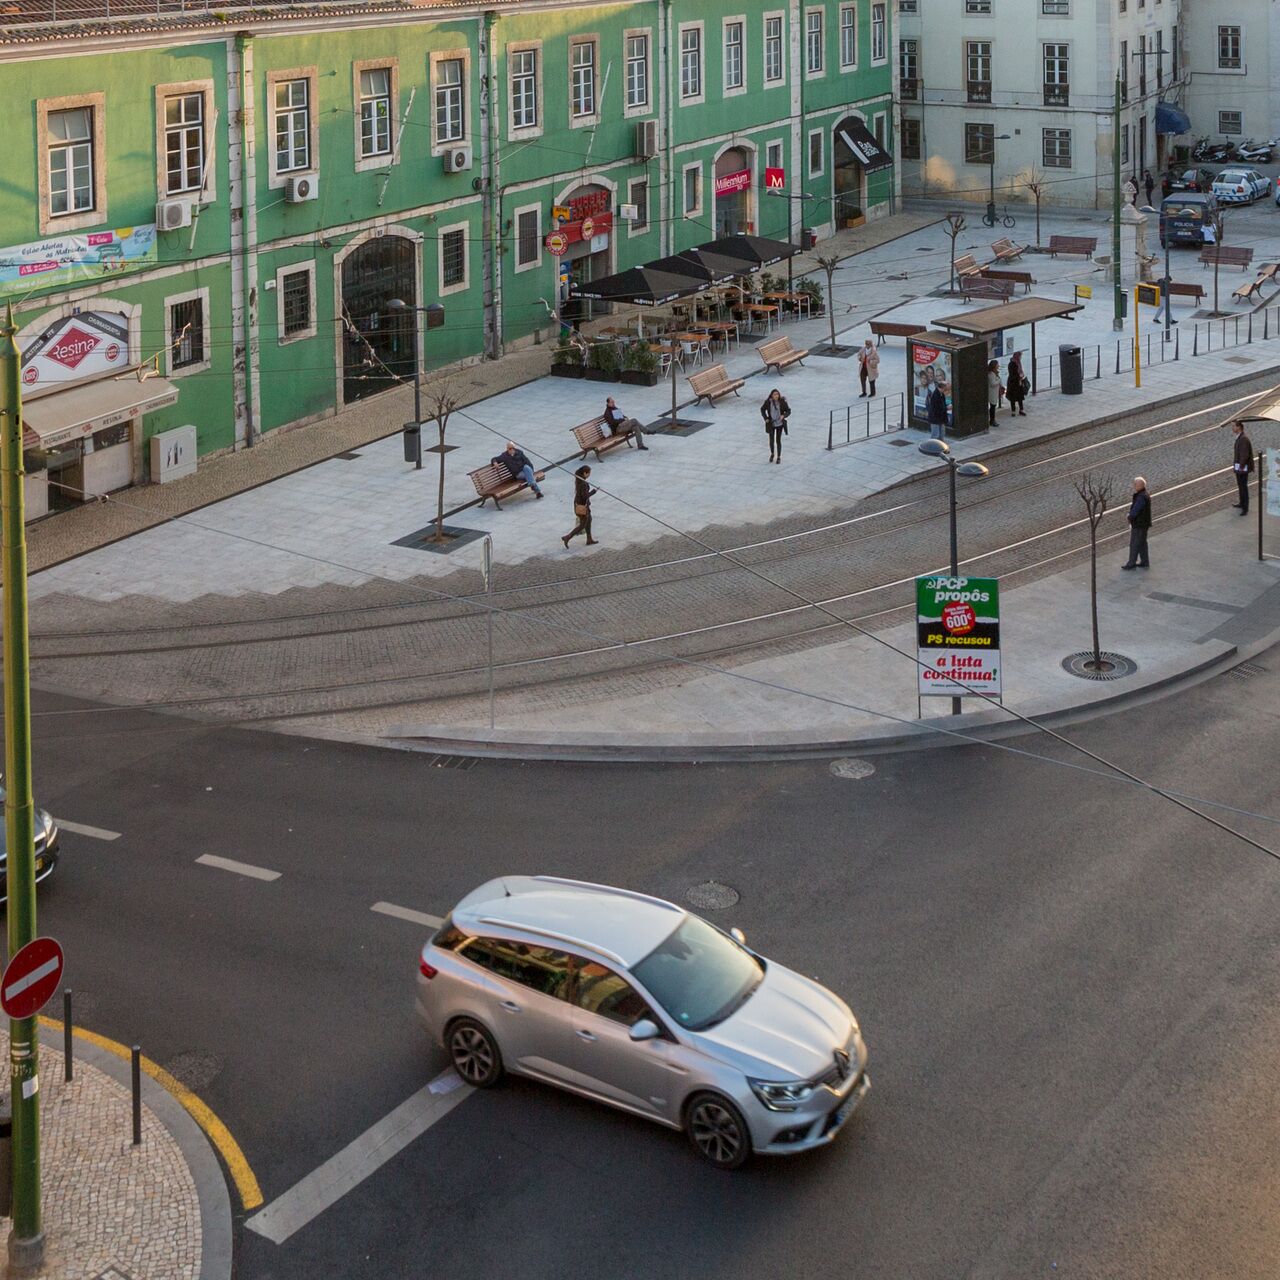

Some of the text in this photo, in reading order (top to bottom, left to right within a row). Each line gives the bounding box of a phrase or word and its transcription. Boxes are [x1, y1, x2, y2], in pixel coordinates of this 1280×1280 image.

[716, 174, 748, 190] Millennium
[569, 190, 609, 207] BURGER
[40, 242, 63, 252] Abertas
[53, 338, 95, 359] Resina
[102, 415, 122, 425] RESINA
[936, 577, 968, 589] PCP
[934, 588, 990, 603] propôs
[946, 613, 972, 628] 600€
[927, 634, 991, 645] PS recusou
[936, 655, 983, 667] a luta
